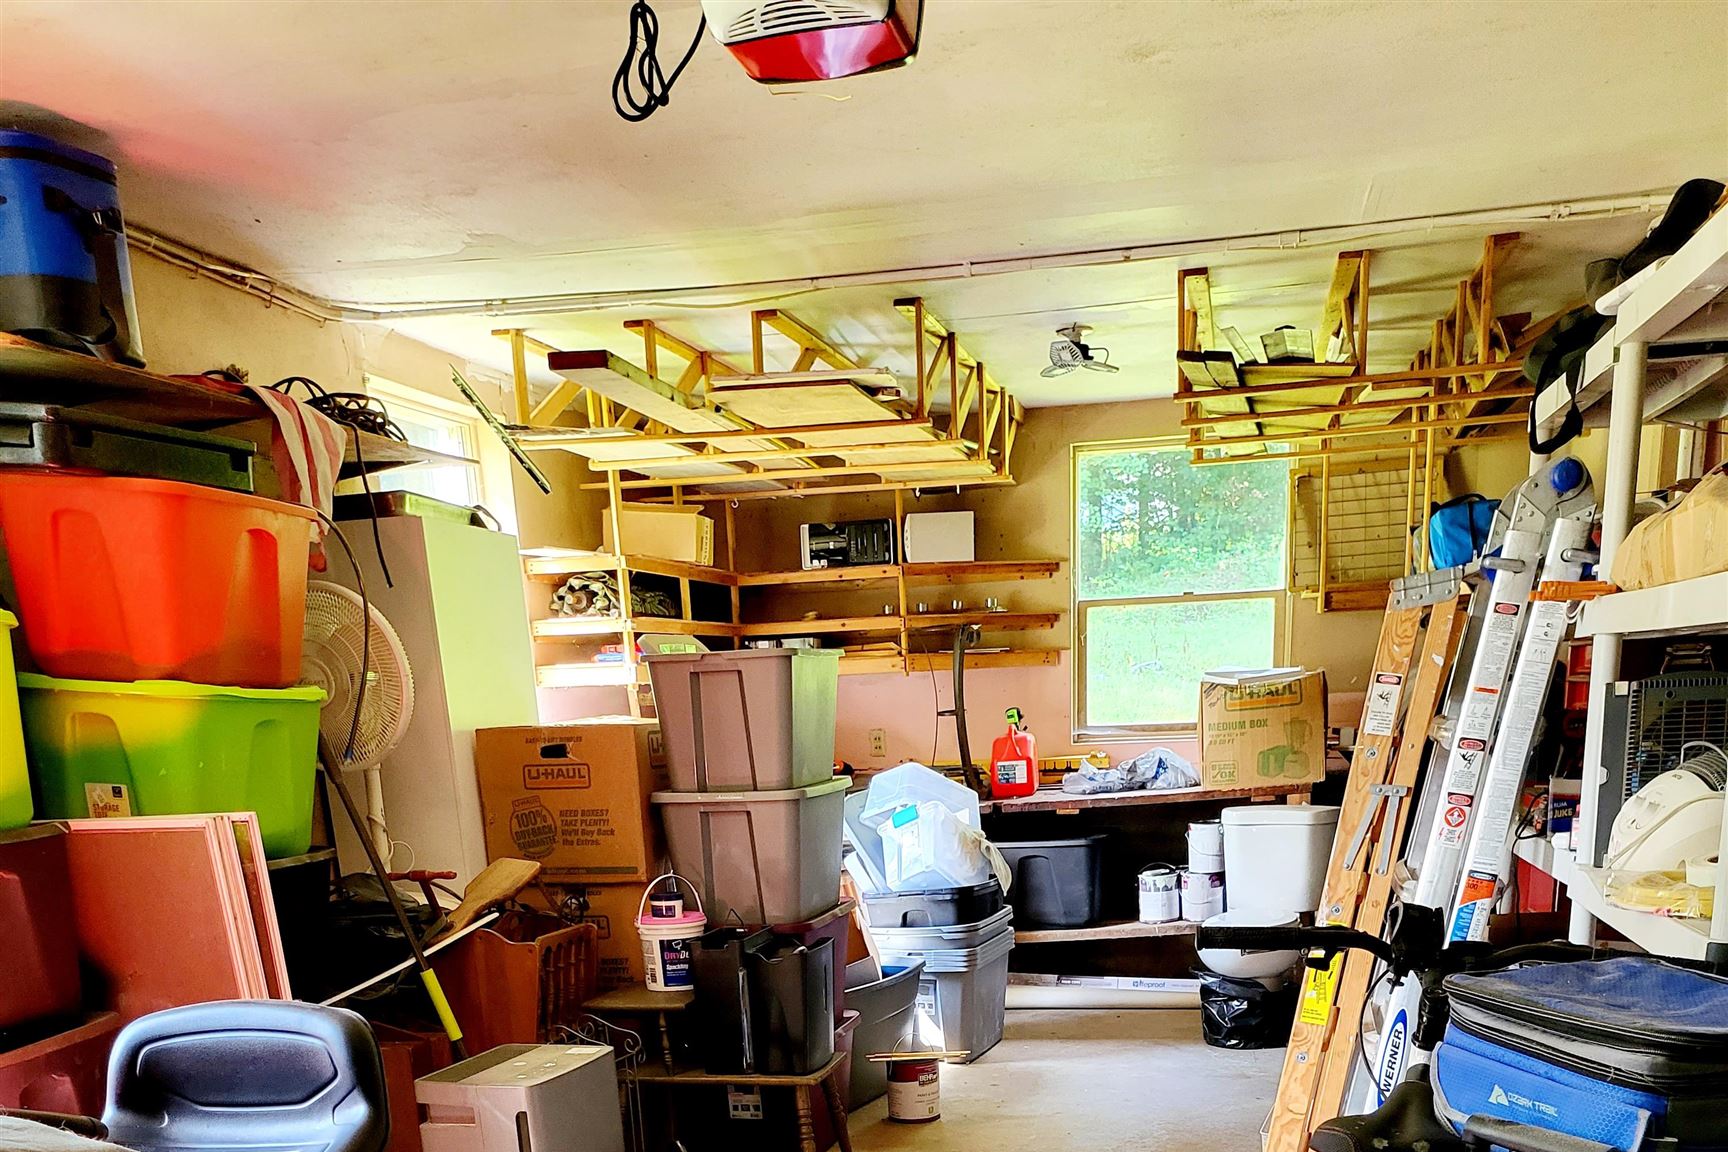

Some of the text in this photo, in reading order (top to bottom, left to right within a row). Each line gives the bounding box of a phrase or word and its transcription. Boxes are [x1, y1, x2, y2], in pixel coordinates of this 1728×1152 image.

[1208, 718, 1269, 732] MEDIUM BOX
[527, 767, 587, 780] U-HAUL
[514, 808, 548, 829] 100%
[559, 808, 609, 817] NEED BOXES?
[560, 818, 610, 827] TAKE PLENTY!
[514, 823, 555, 841] BUY-BACK
[1382, 1028, 1403, 1093] WERNER
[1507, 1092, 1534, 1109] OZARK
[1533, 1100, 1559, 1117] TRAIL
